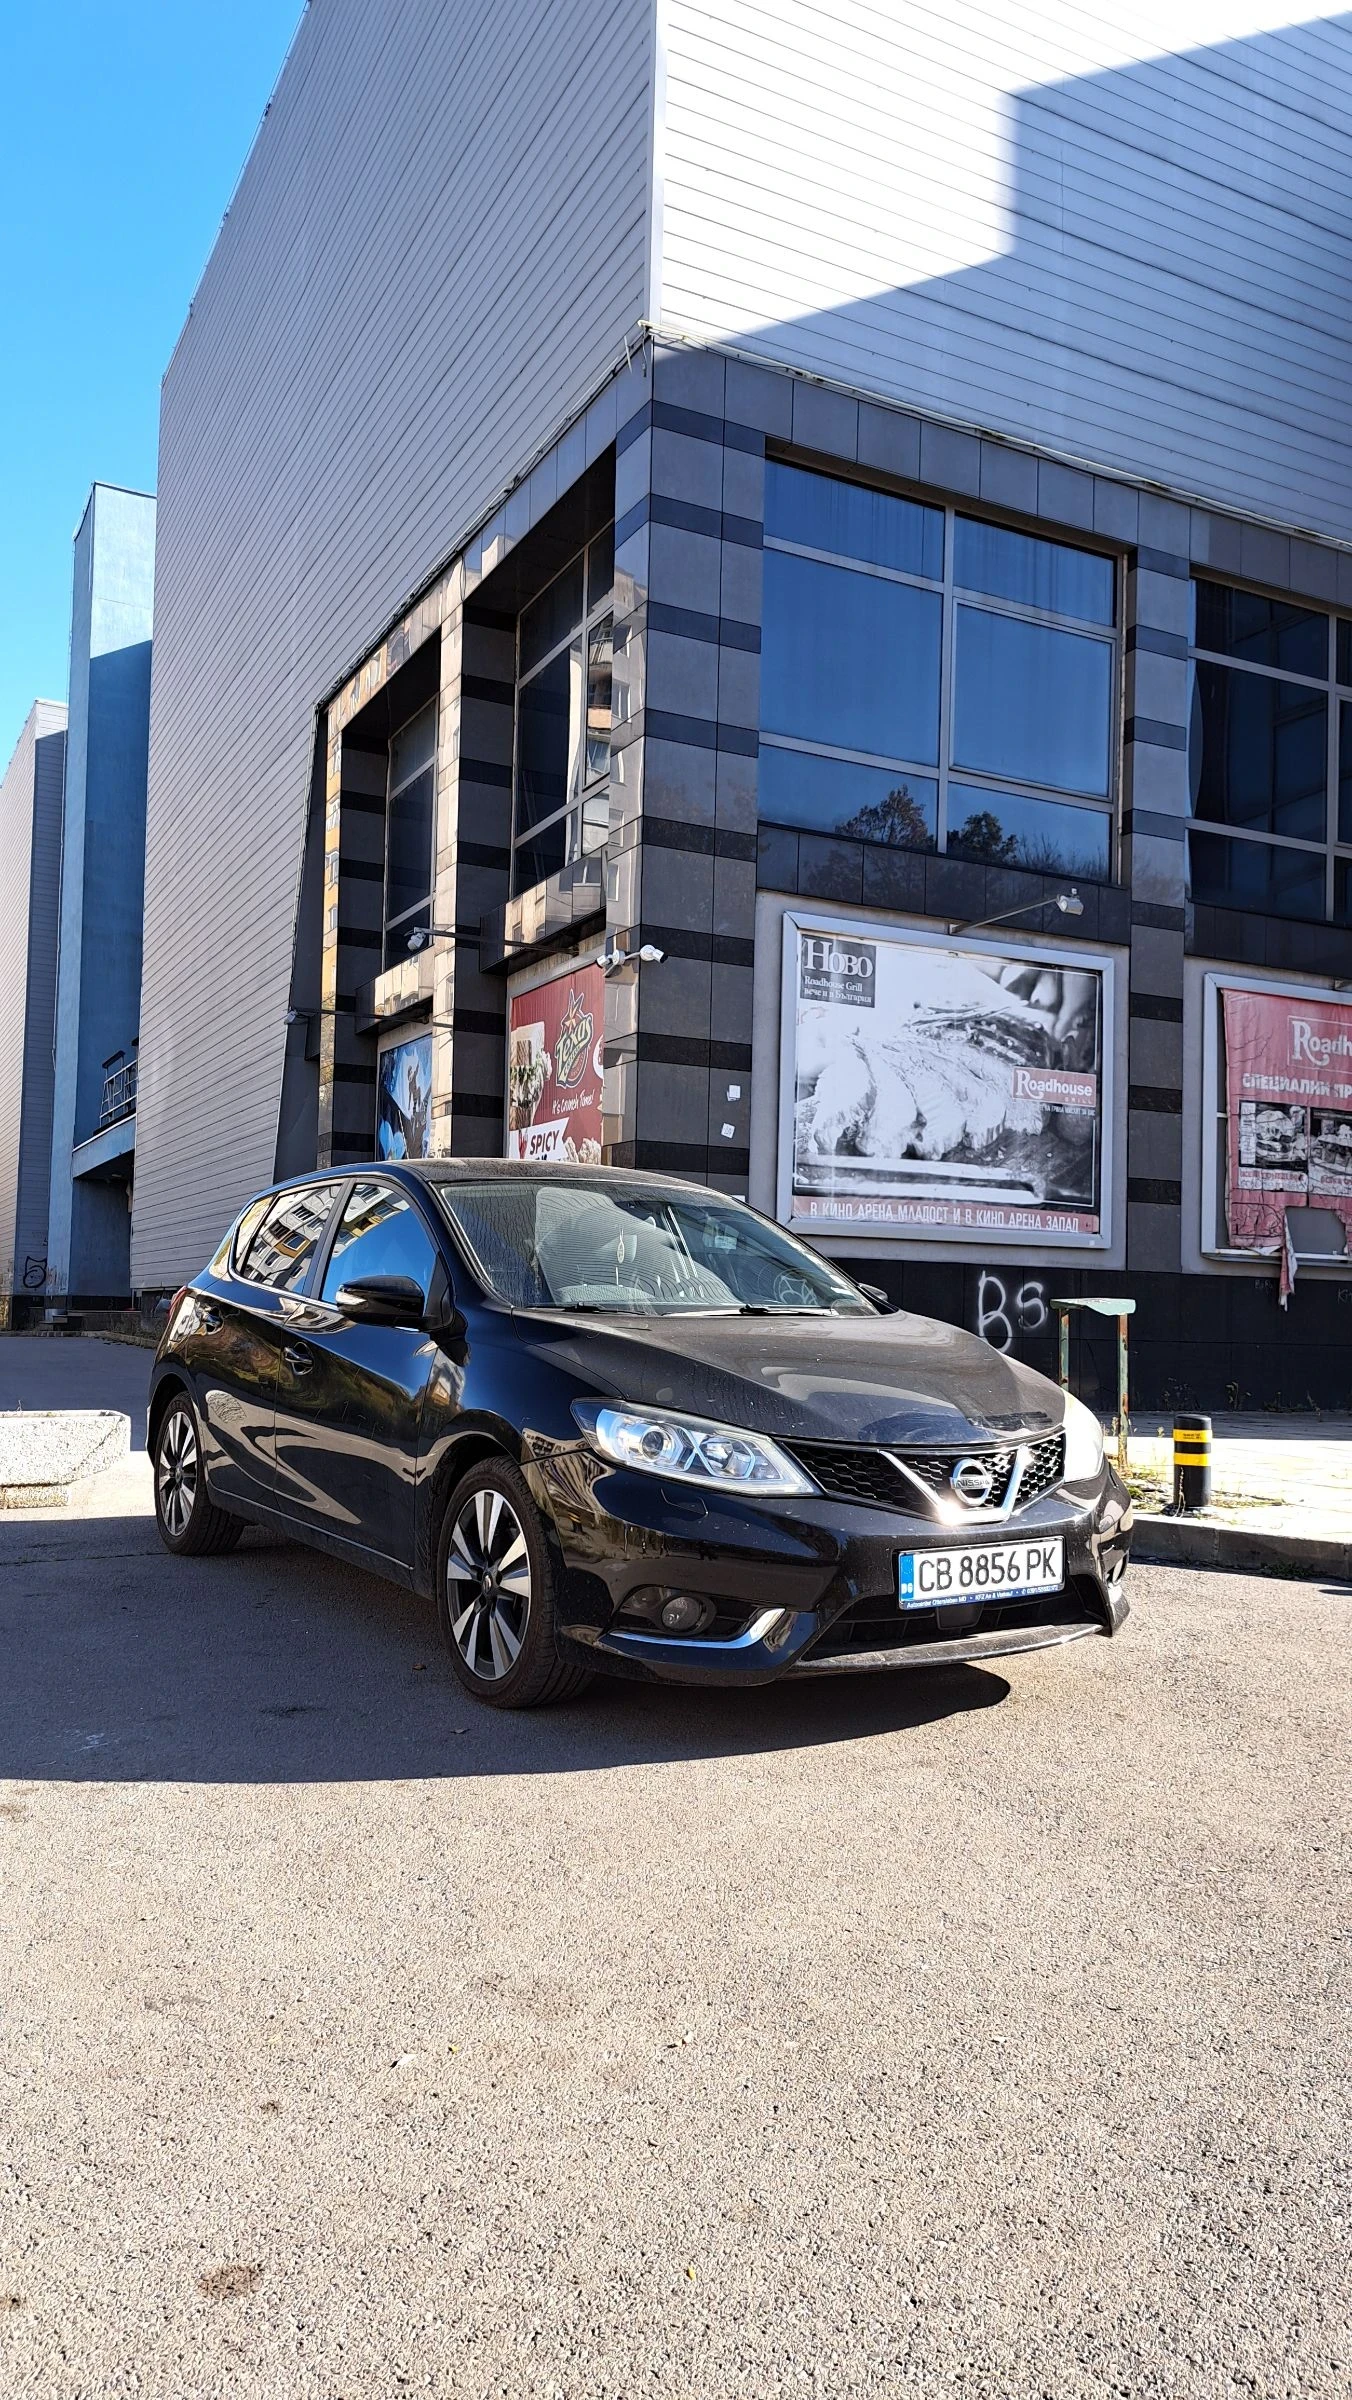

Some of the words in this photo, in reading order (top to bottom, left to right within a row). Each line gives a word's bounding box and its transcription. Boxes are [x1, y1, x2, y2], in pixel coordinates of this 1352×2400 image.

[804, 976, 844, 990] Roadhouse
[846, 981, 863, 992] Grill
[835, 990, 872, 1004] България
[1016, 1069, 1093, 1099] Roadhouse
[1242, 1072, 1330, 1096] СПЕЦИАЛНИ
[530, 1130, 560, 1155] SPICY
[810, 1202, 818, 1217] В
[823, 1202, 853, 1219] КИНО
[858, 1203, 894, 1221] АРЕНА
[898, 1205, 949, 1224] МЛАДОСТ
[953, 1207, 960, 1223] И
[965, 1208, 972, 1225] В
[976, 1209, 1004, 1226] КИНО
[1008, 1211, 1041, 1230] АРЕНА
[1045, 1215, 1079, 1233] ЗАПАД
[955, 1479, 990, 1489] NISSAN
[919, 1557, 952, 1592] CB
[959, 1551, 1020, 1588] 8856
[1026, 1547, 1057, 1580] PK
